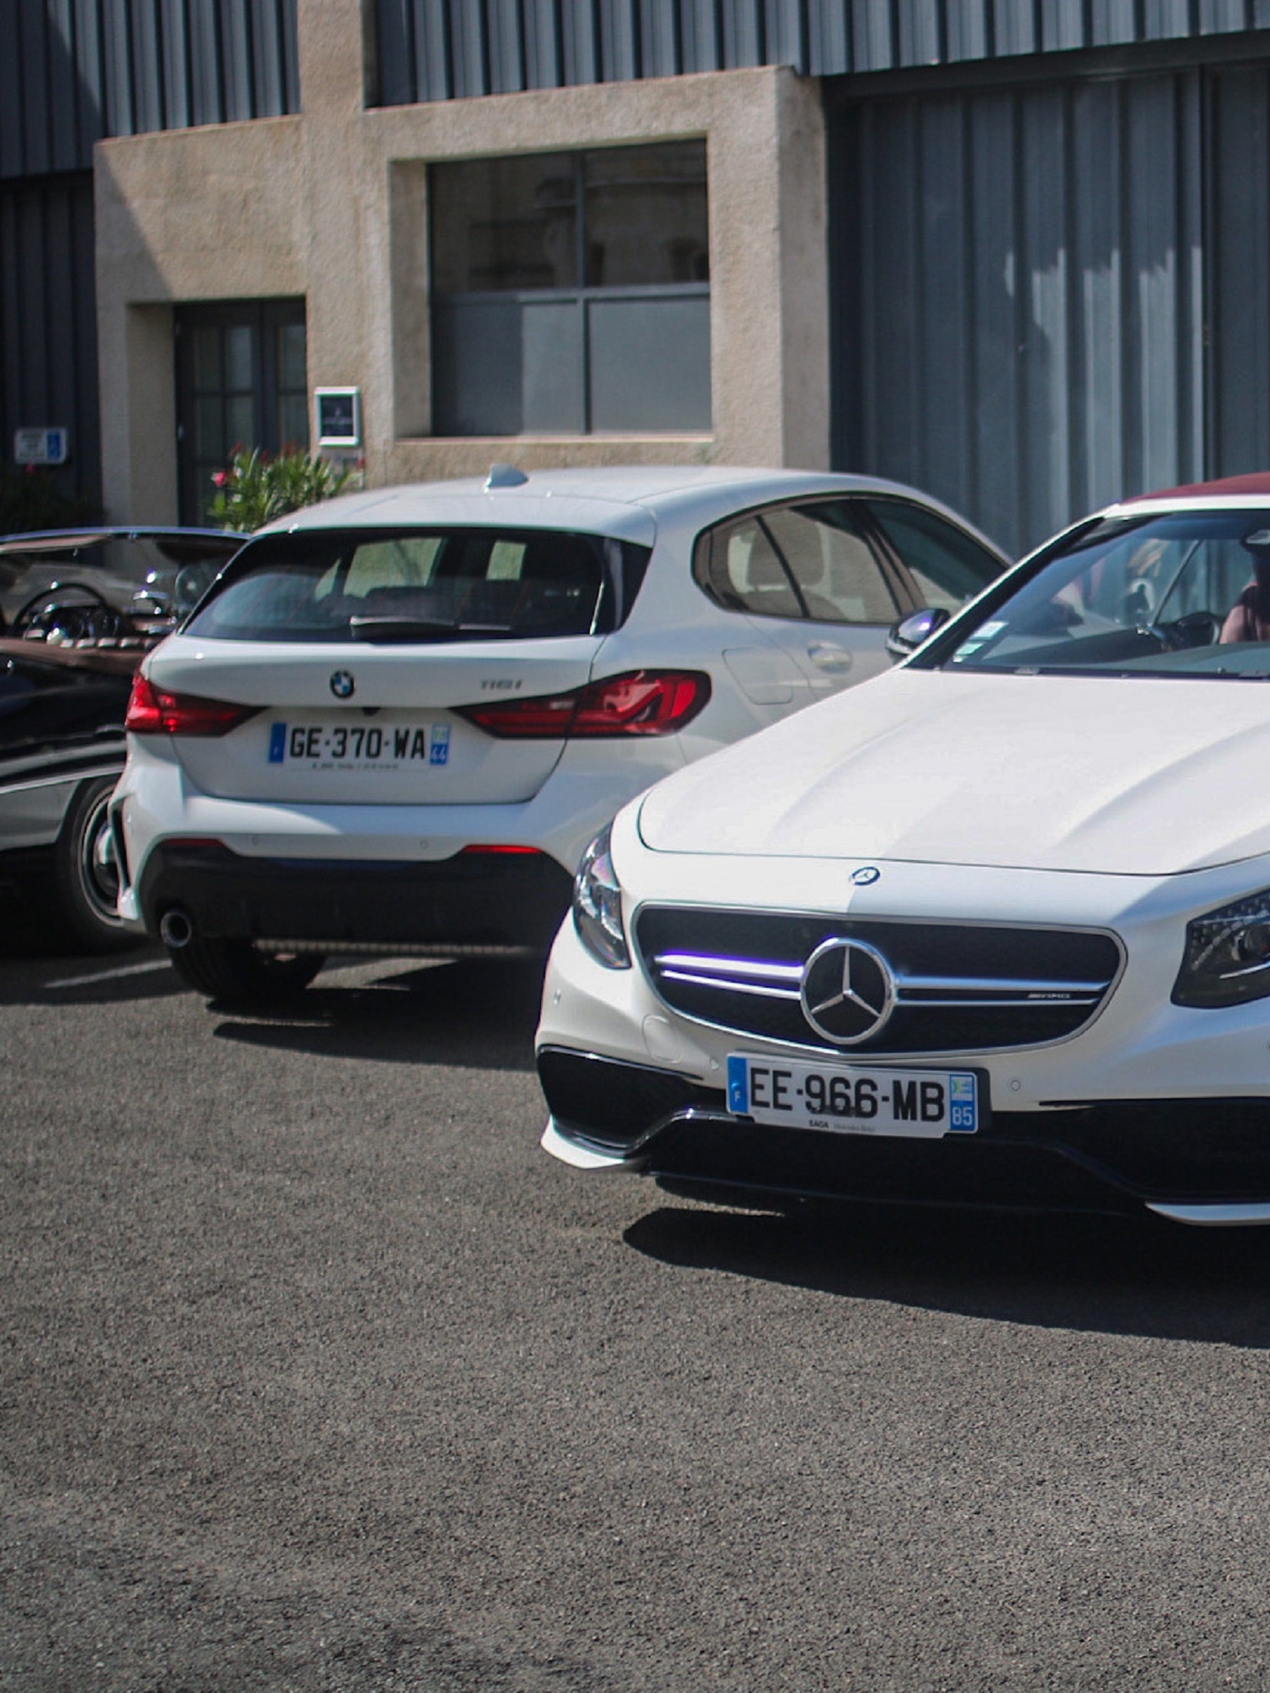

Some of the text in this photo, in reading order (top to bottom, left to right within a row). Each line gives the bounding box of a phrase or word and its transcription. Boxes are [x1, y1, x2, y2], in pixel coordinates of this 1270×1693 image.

[290, 727, 425, 759] GE-370-WA
[431, 745, 447, 761] 44
[734, 1091, 742, 1102] F
[750, 1067, 945, 1123] EE-966-MB
[952, 1106, 973, 1126] 85
